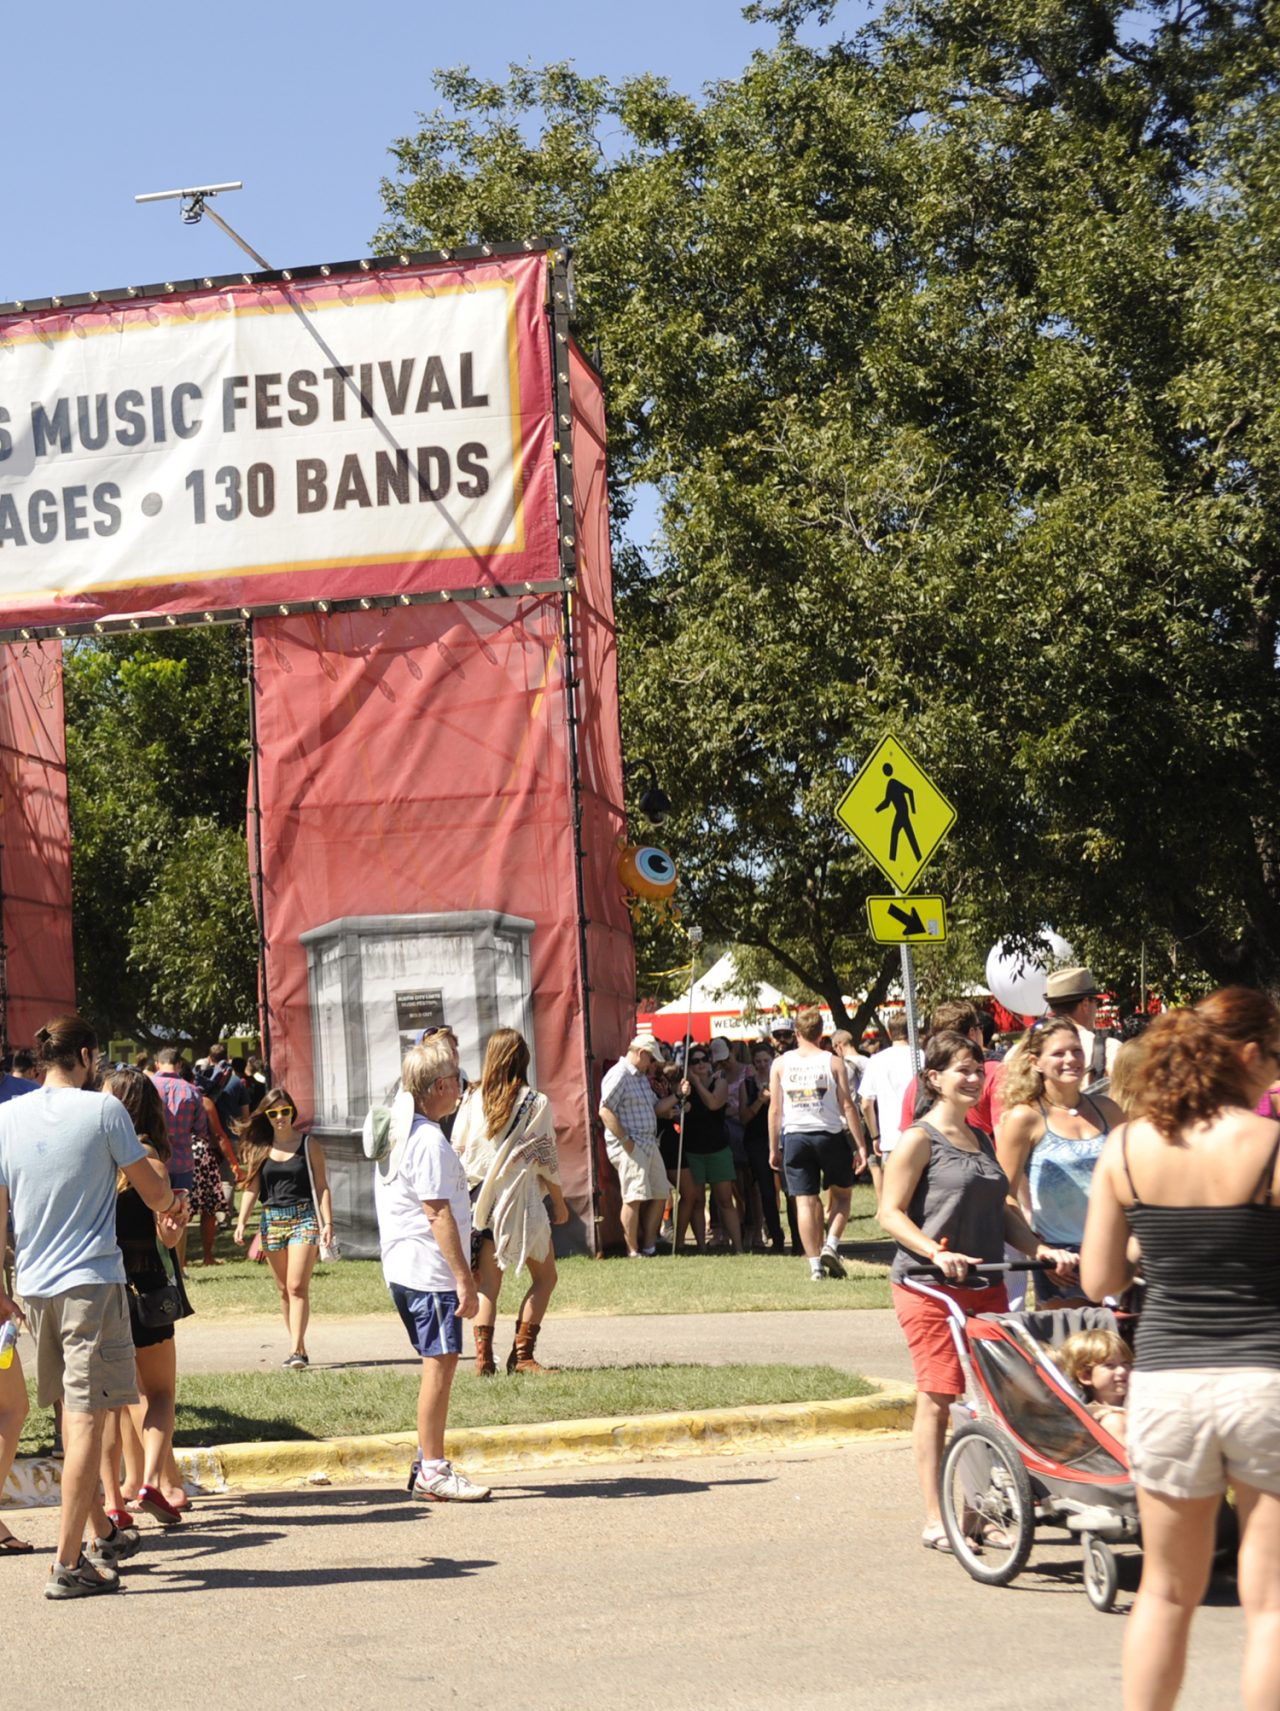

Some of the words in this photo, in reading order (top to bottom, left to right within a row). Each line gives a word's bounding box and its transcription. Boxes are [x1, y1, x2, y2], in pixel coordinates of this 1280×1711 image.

[30, 382, 203, 457] MUSIC
[222, 351, 489, 433] FESTIVAL
[185, 462, 276, 525] 130
[296, 442, 490, 515] BANDS
